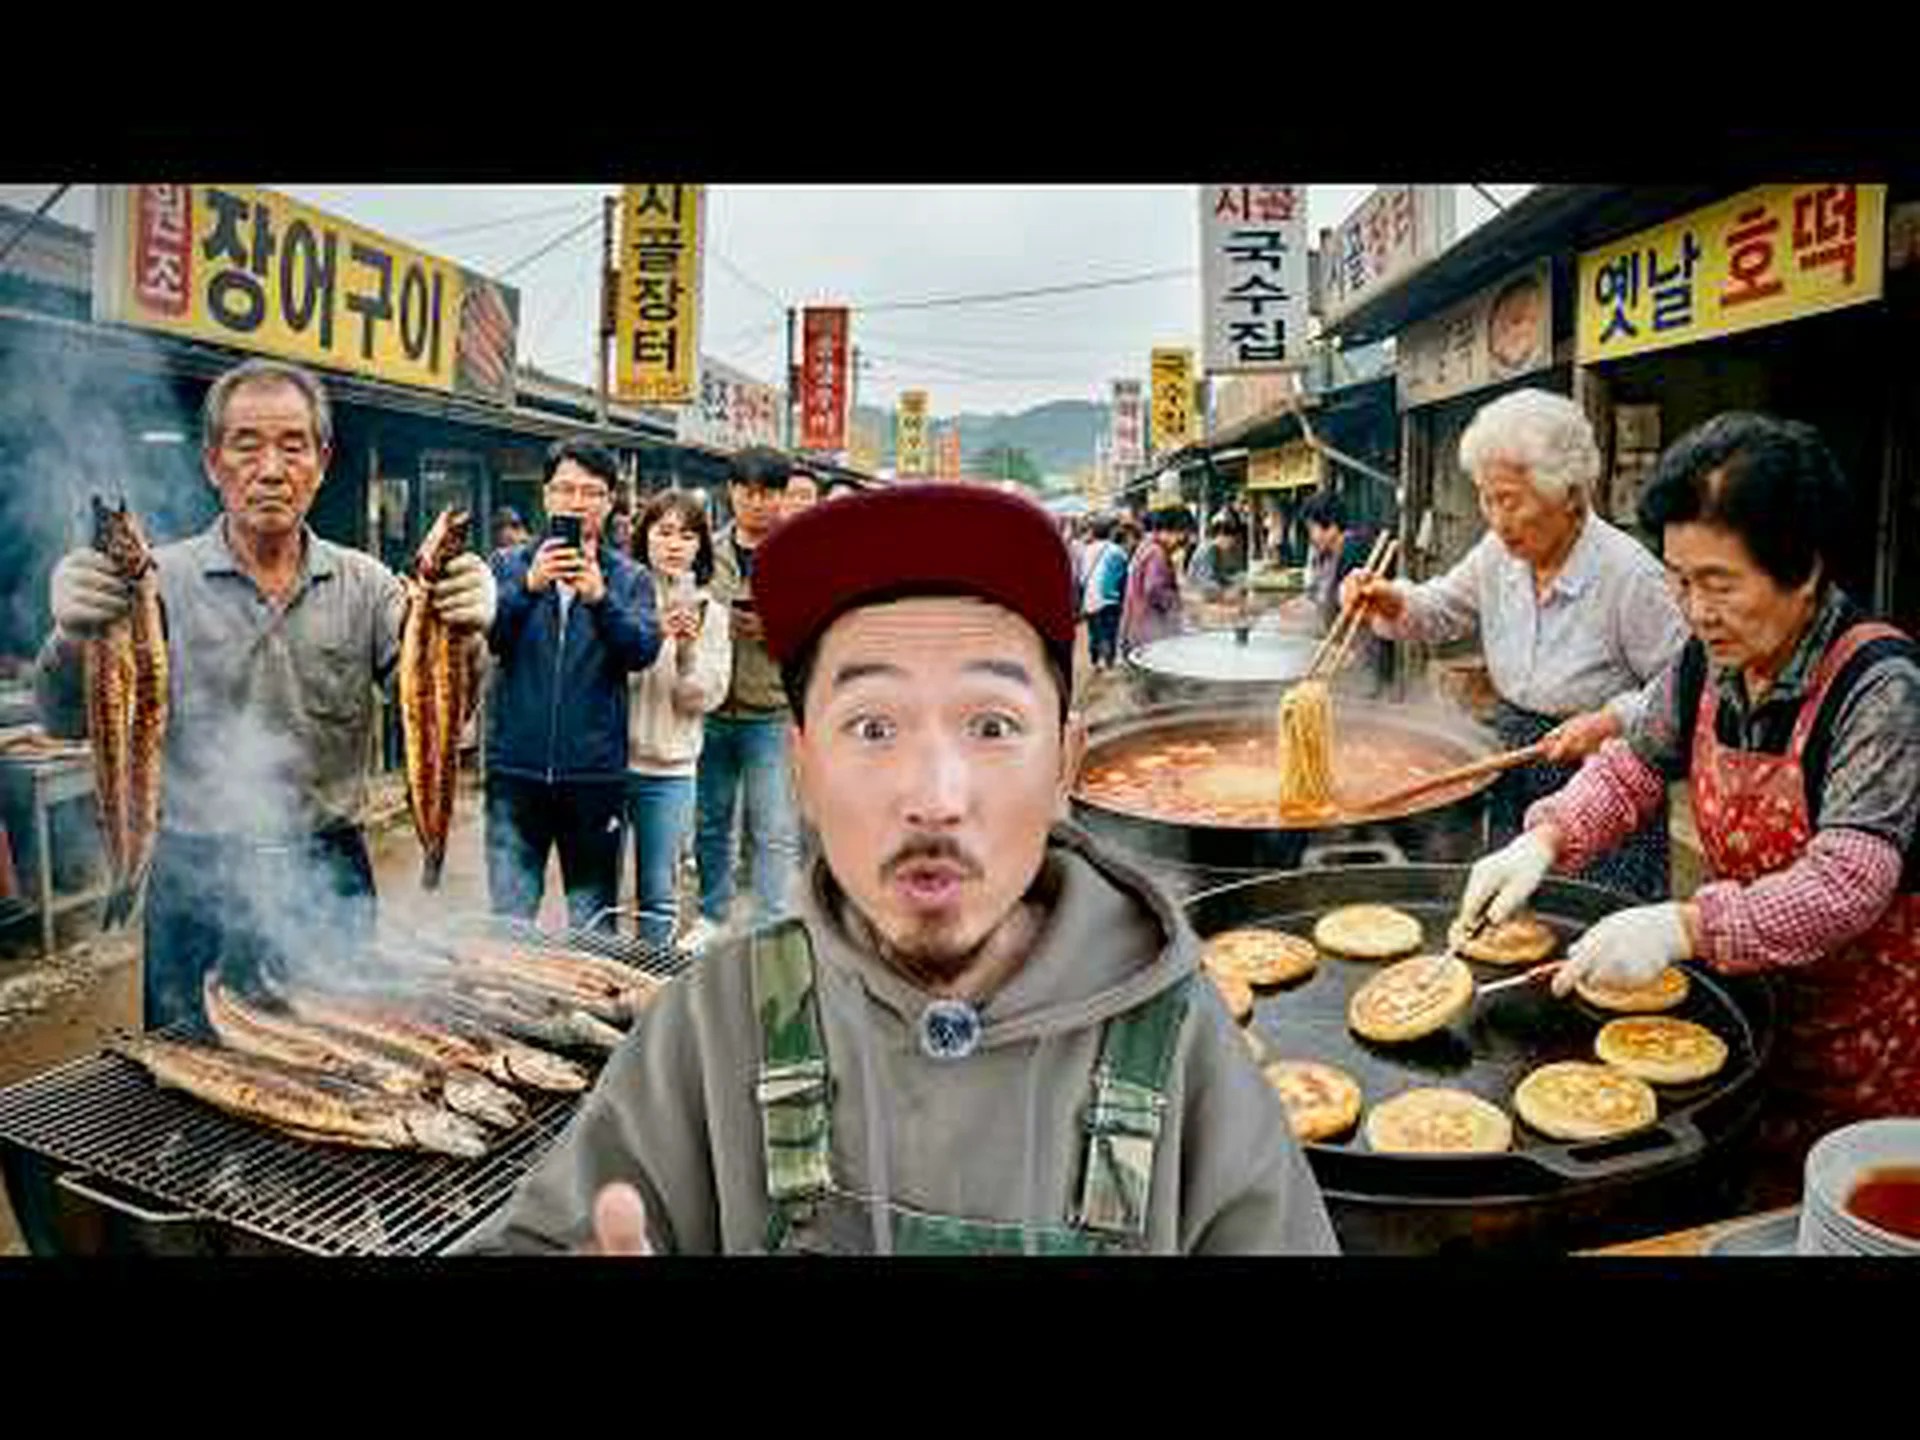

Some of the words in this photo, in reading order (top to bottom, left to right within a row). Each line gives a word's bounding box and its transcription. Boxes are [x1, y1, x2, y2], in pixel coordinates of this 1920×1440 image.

[203, 189, 443, 375] 장어구이
[633, 185, 687, 372] 시골장터
[1216, 186, 1295, 220] 시골
[1596, 232, 1699, 344] 옛날
[1720, 186, 1859, 306] 호떡
[1223, 230, 1290, 361] 국수집
